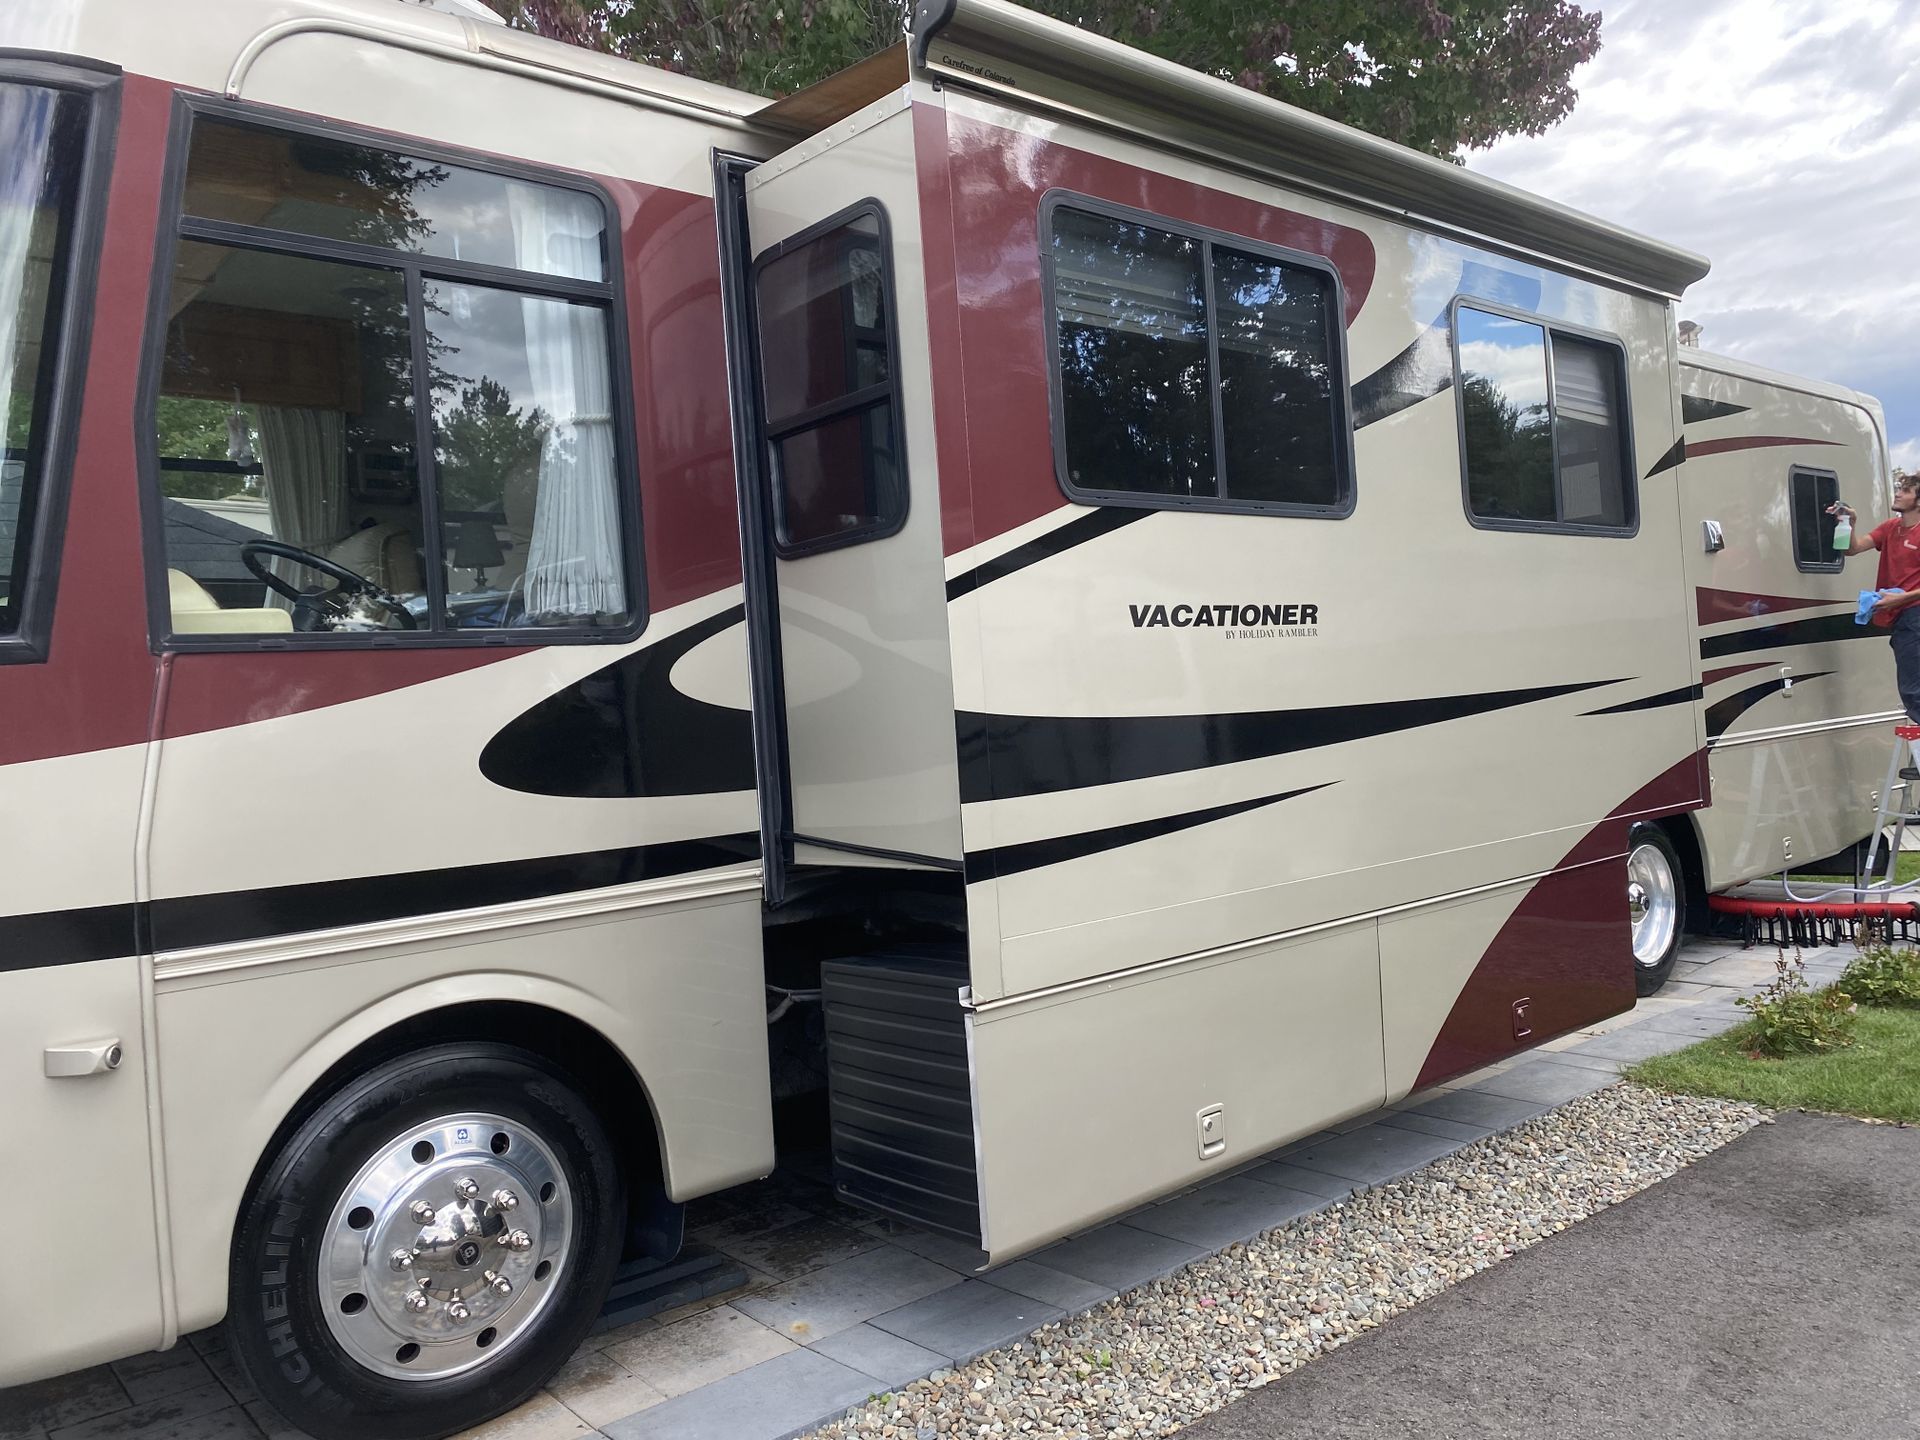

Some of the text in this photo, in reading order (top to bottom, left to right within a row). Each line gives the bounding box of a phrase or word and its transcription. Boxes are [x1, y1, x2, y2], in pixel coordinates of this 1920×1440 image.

[942, 55, 1016, 86] Carefree of Colorado
[1129, 604, 1319, 628] VACATIONER
[1226, 628, 1318, 639] BY HOLIDAY RAMBLER
